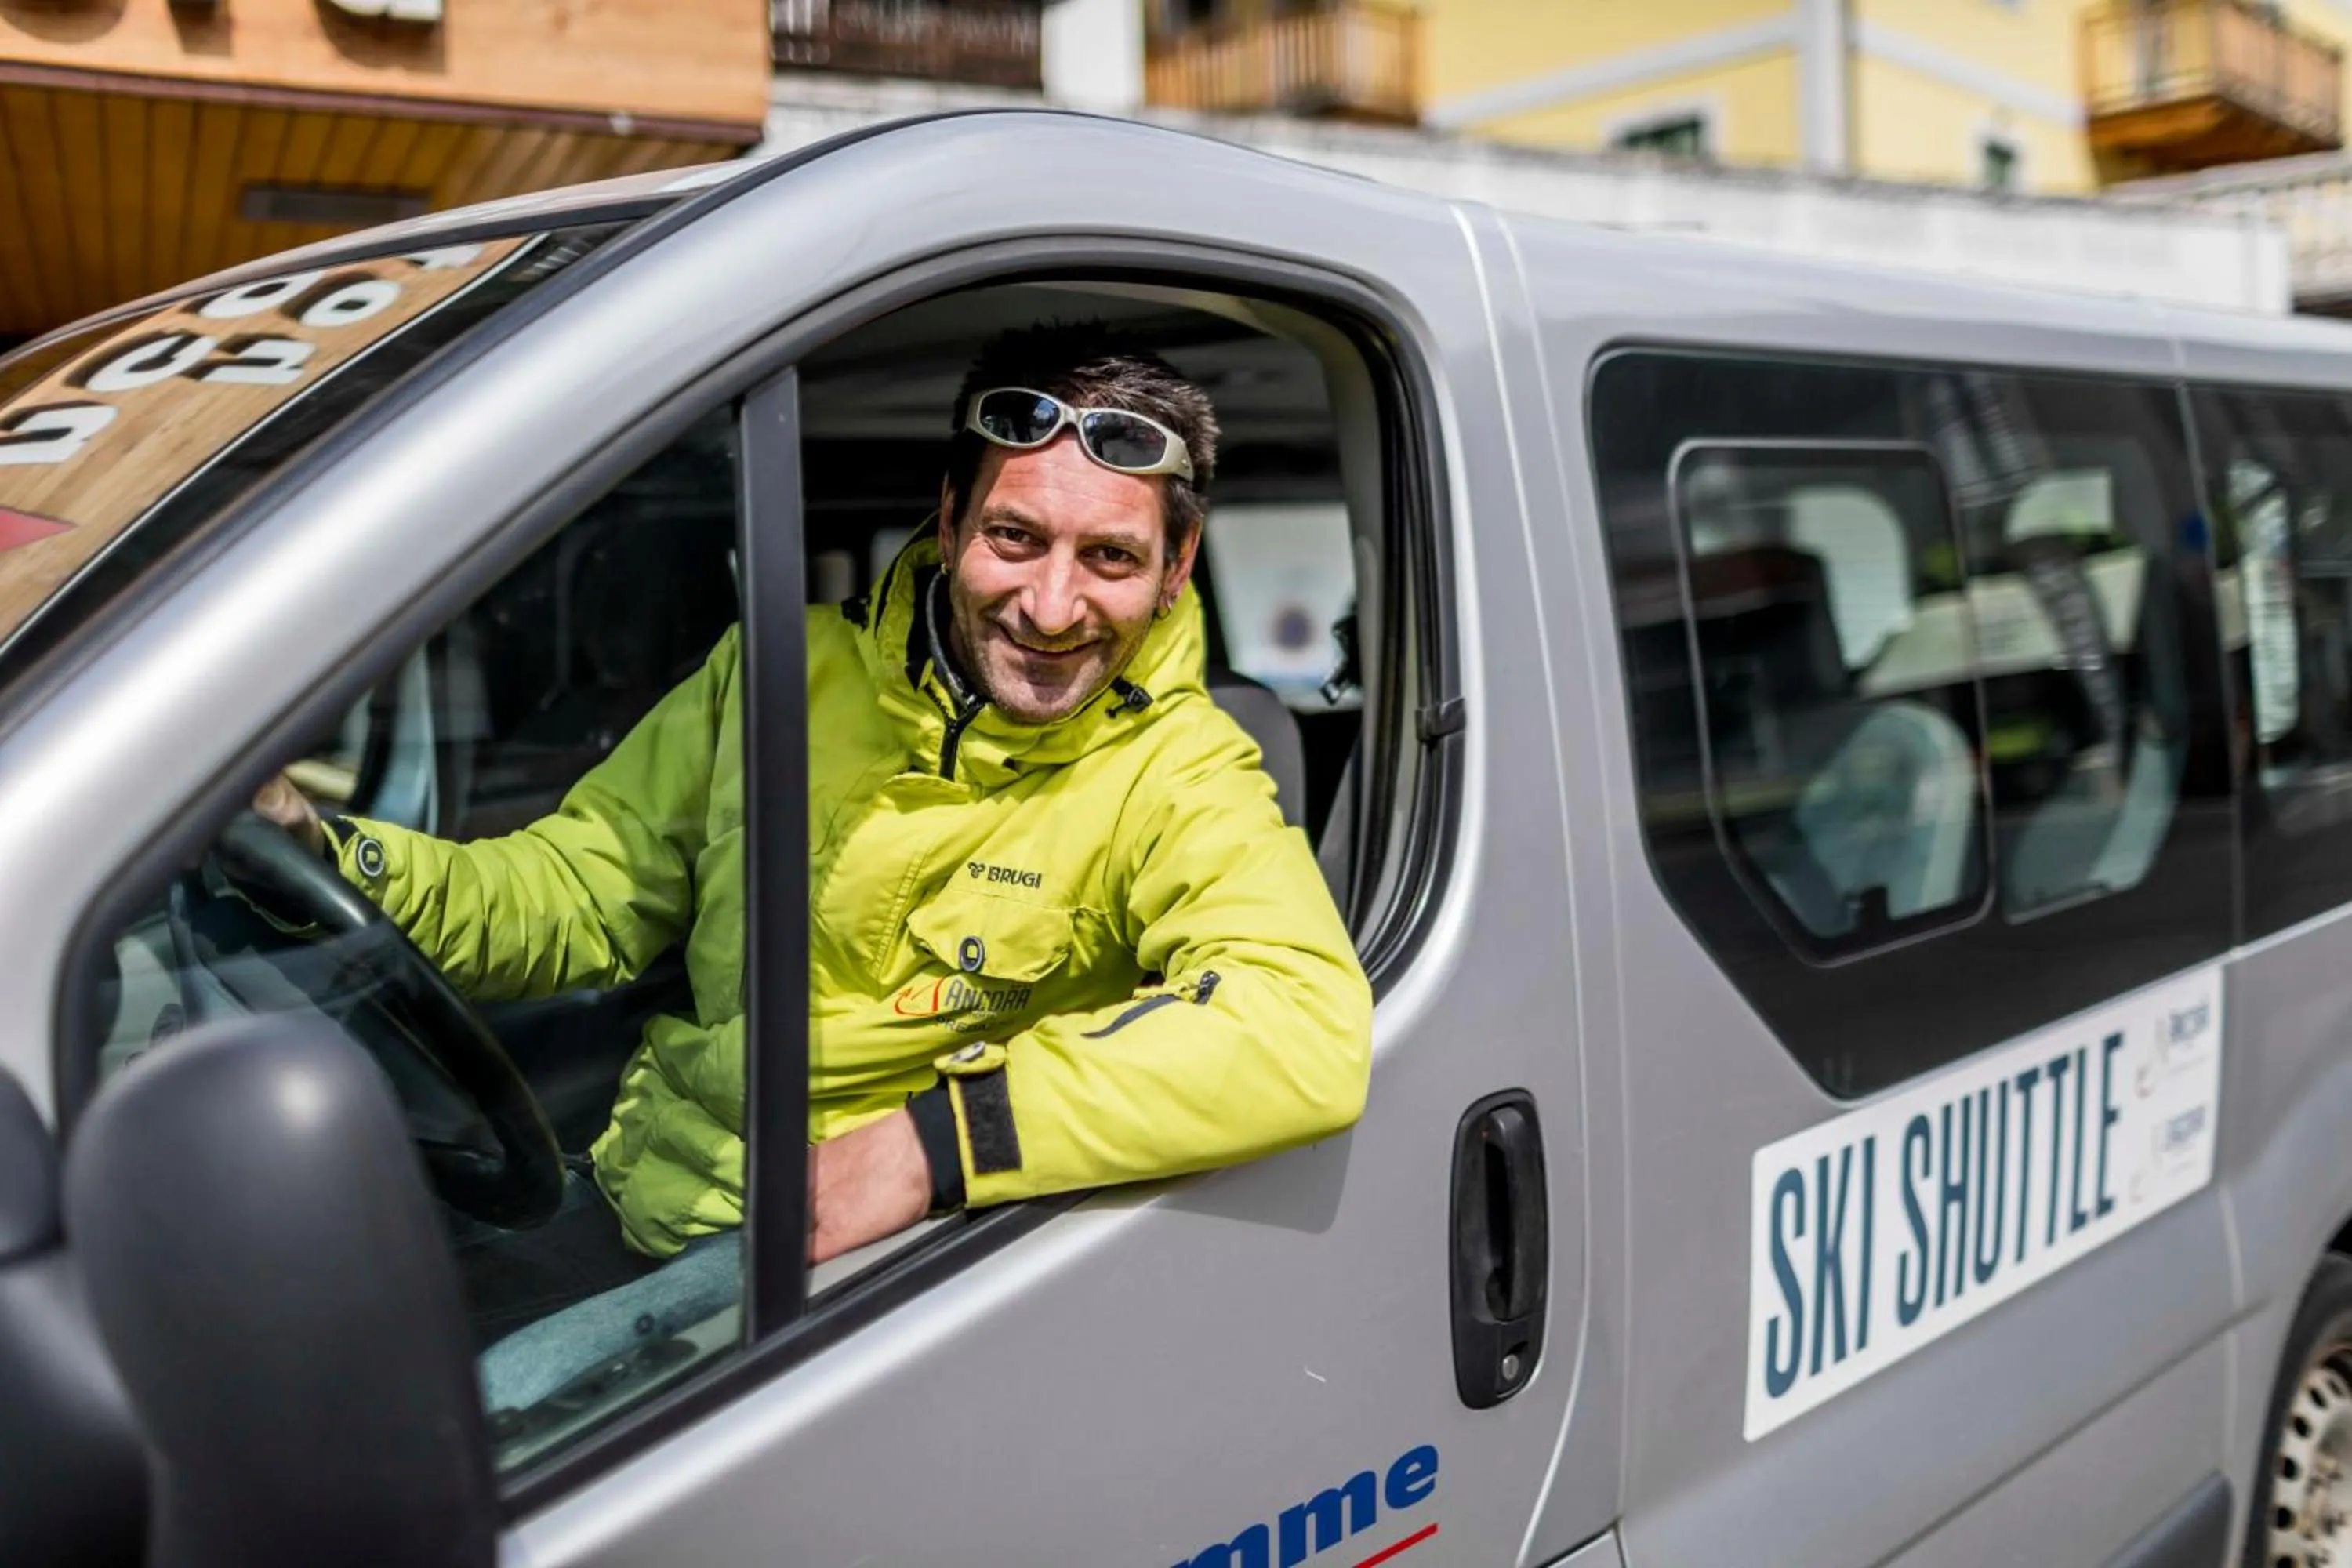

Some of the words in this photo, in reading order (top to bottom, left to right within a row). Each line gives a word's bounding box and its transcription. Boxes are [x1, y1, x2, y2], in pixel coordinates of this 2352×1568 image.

[986, 866, 1043, 889] BRUGI
[1765, 1134, 1877, 1399] SKI
[1896, 1030, 2124, 1327] SHUTTLE
